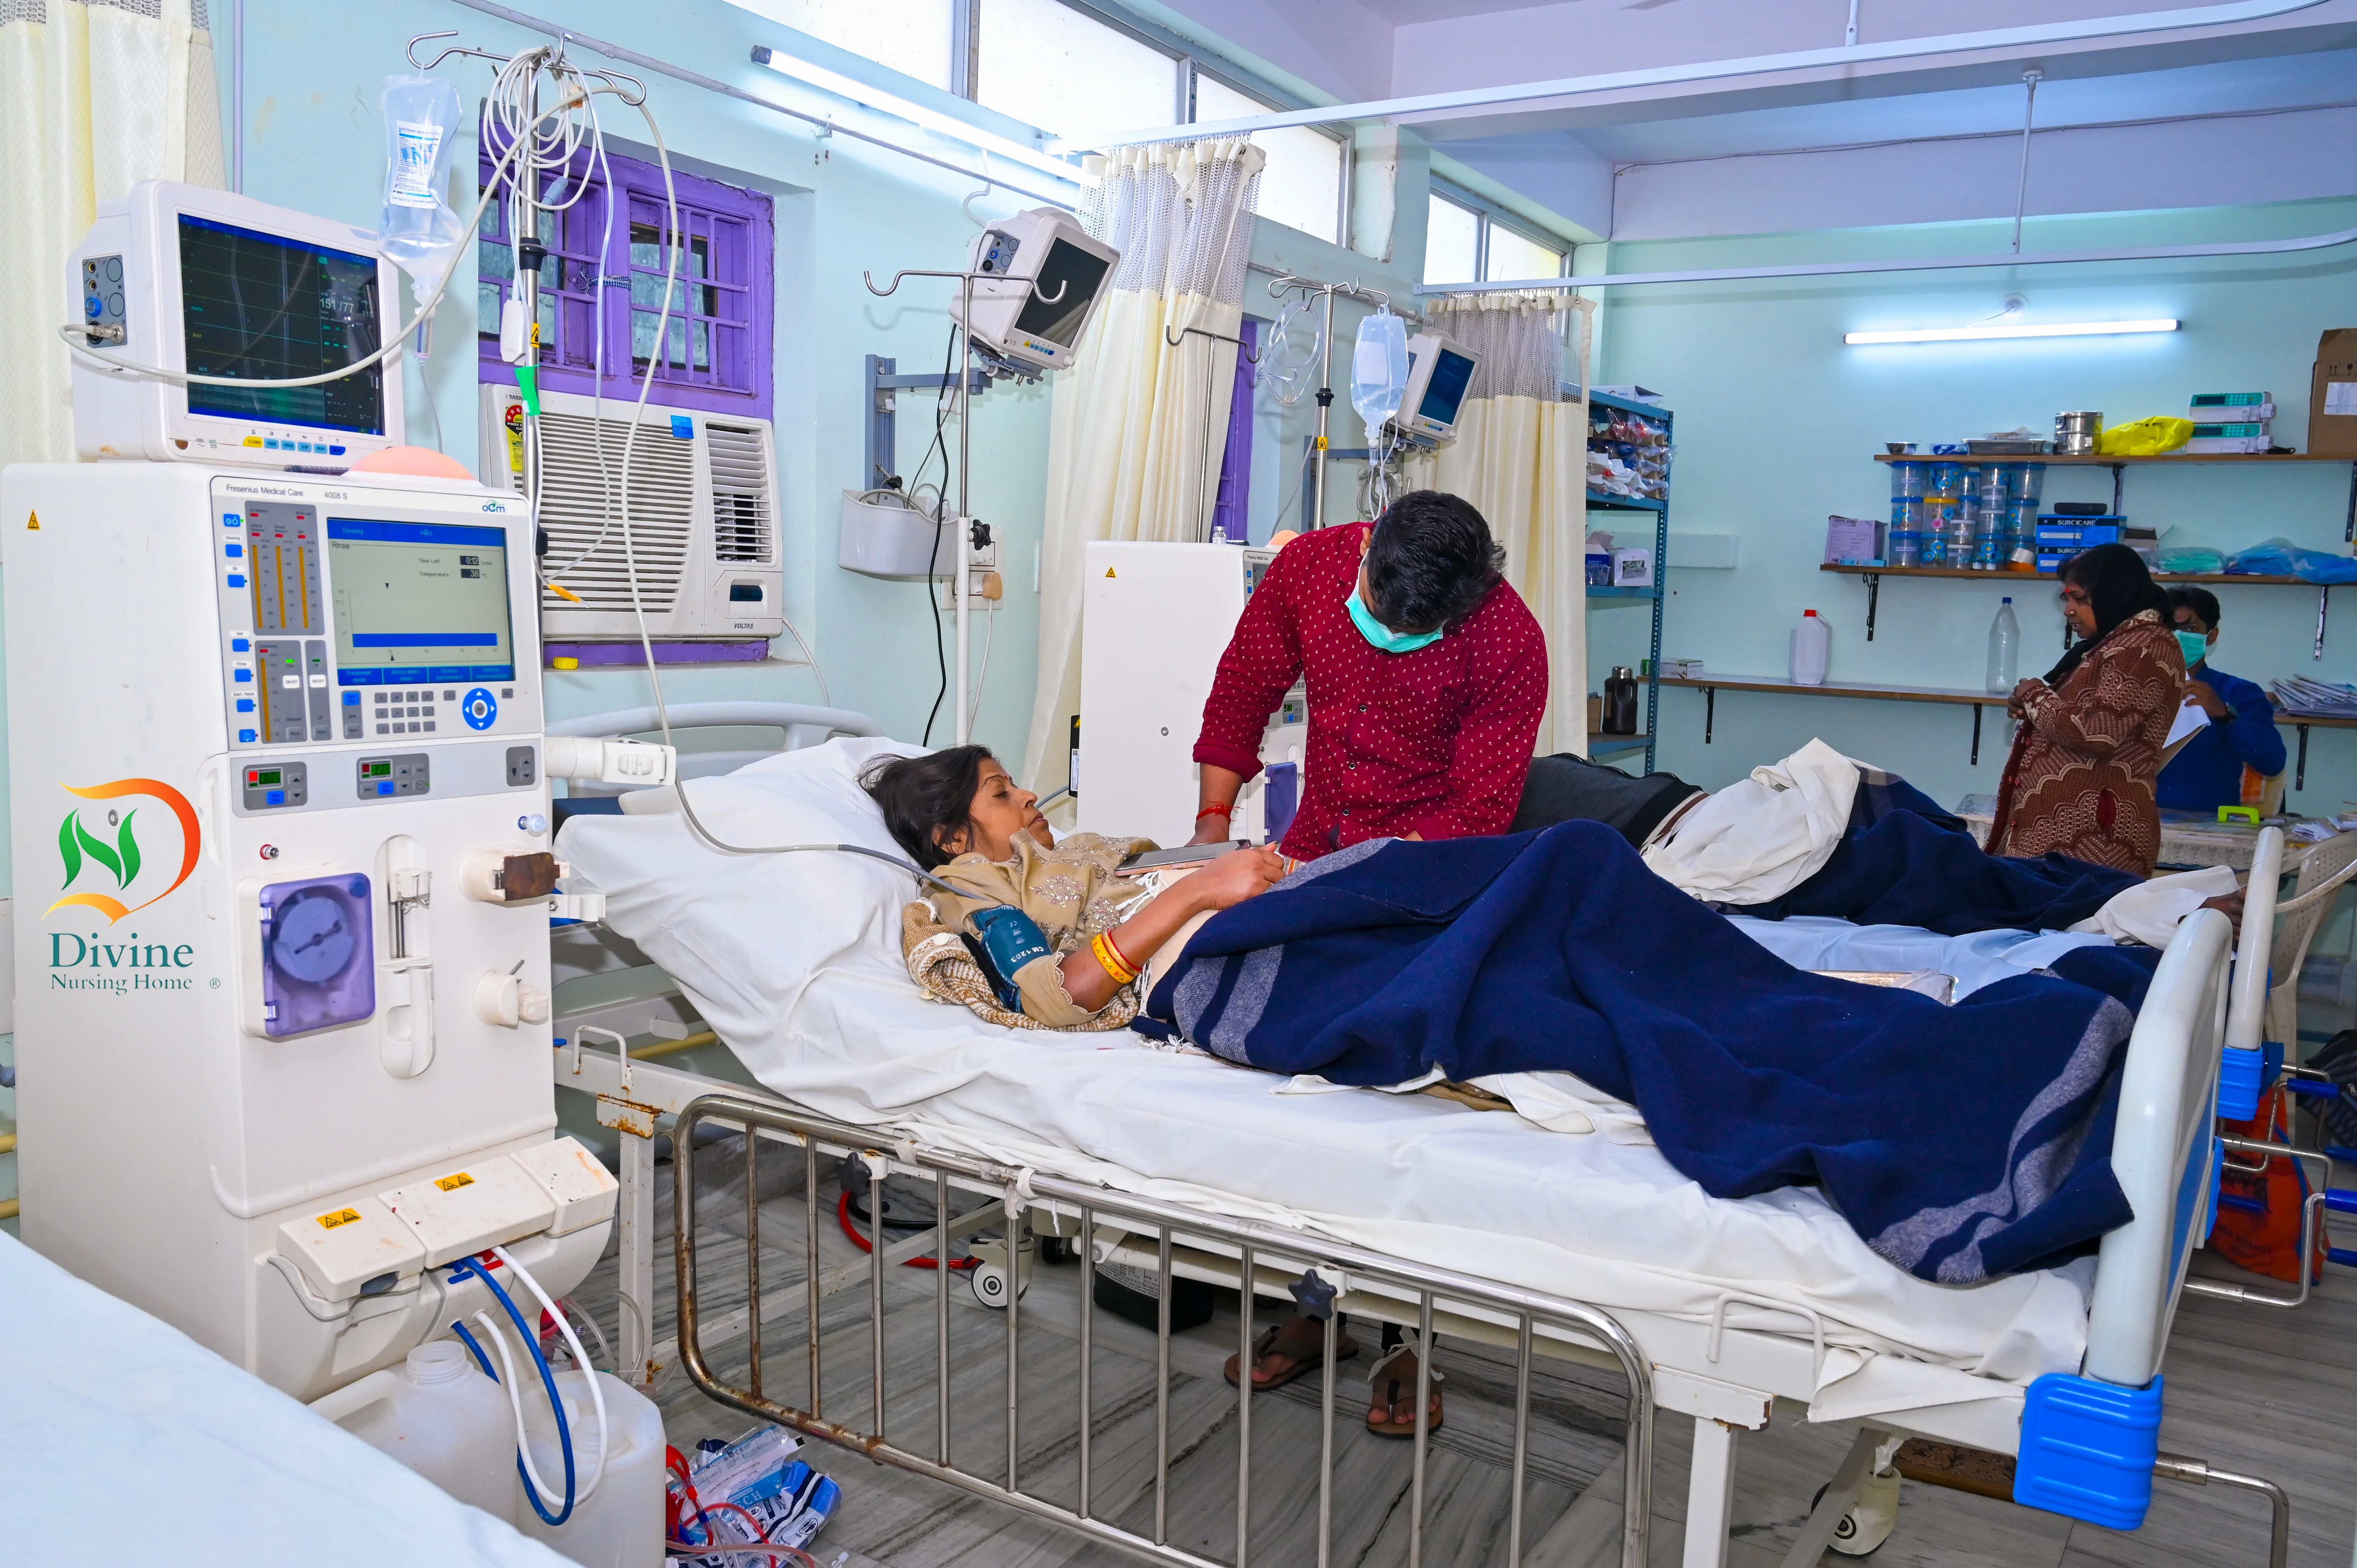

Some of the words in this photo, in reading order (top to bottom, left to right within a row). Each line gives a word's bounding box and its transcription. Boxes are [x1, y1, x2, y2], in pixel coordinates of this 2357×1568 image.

[226, 484, 258, 493] Fresenius
[261, 487, 285, 495] Medical
[262, 773, 279, 782] 170
[1011, 950, 1031, 962] 1203
